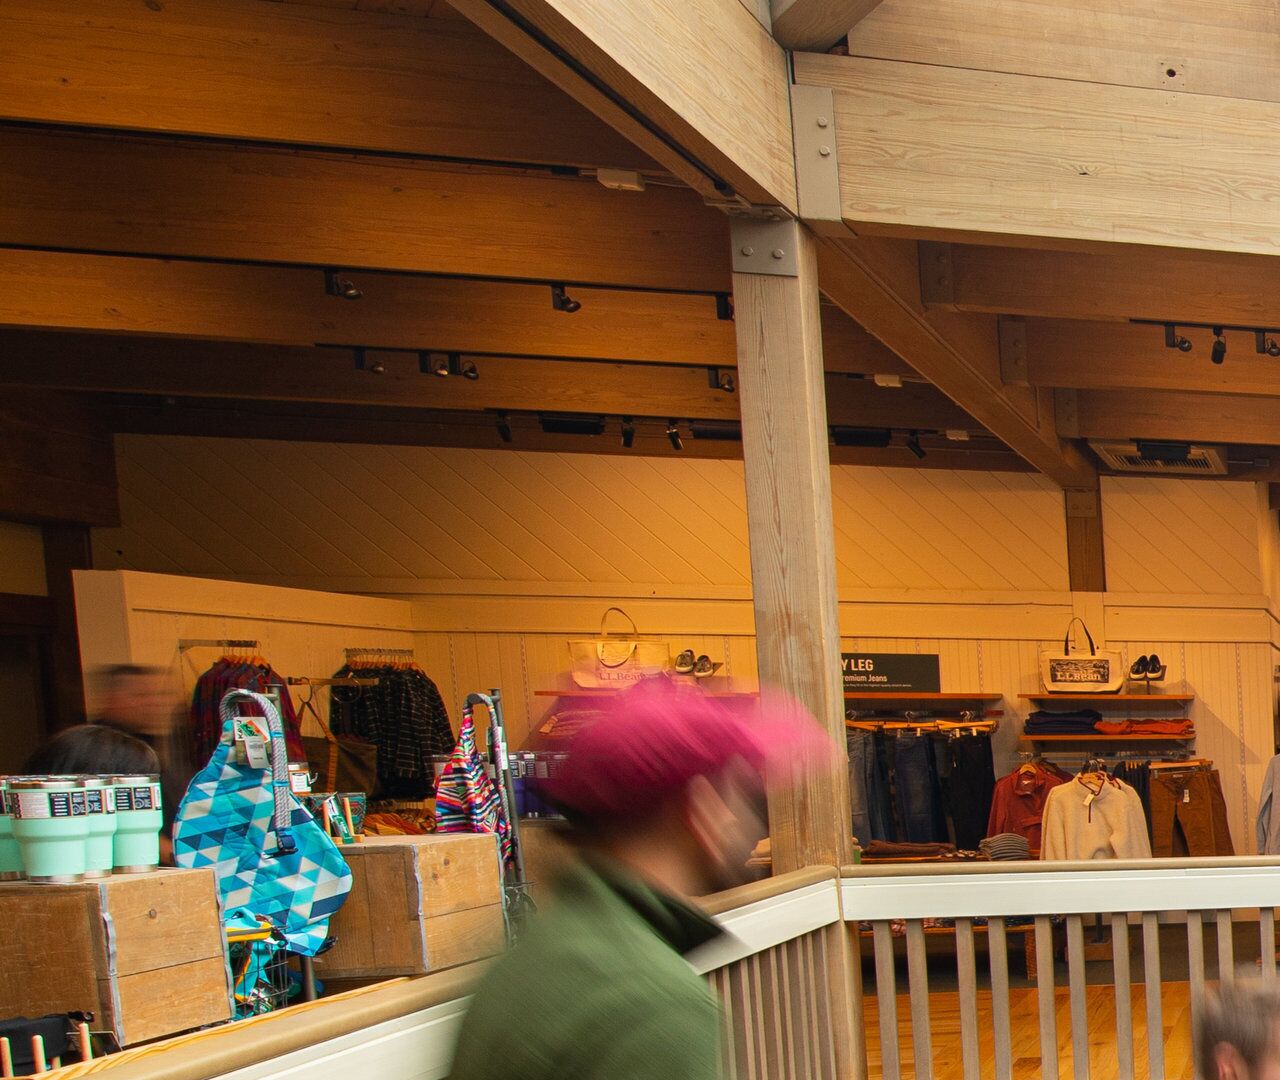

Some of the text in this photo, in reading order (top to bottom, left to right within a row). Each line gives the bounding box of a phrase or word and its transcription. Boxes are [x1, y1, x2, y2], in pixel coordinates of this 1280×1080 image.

[850, 659, 874, 671] LEG
[841, 674, 888, 682] remium Jeans
